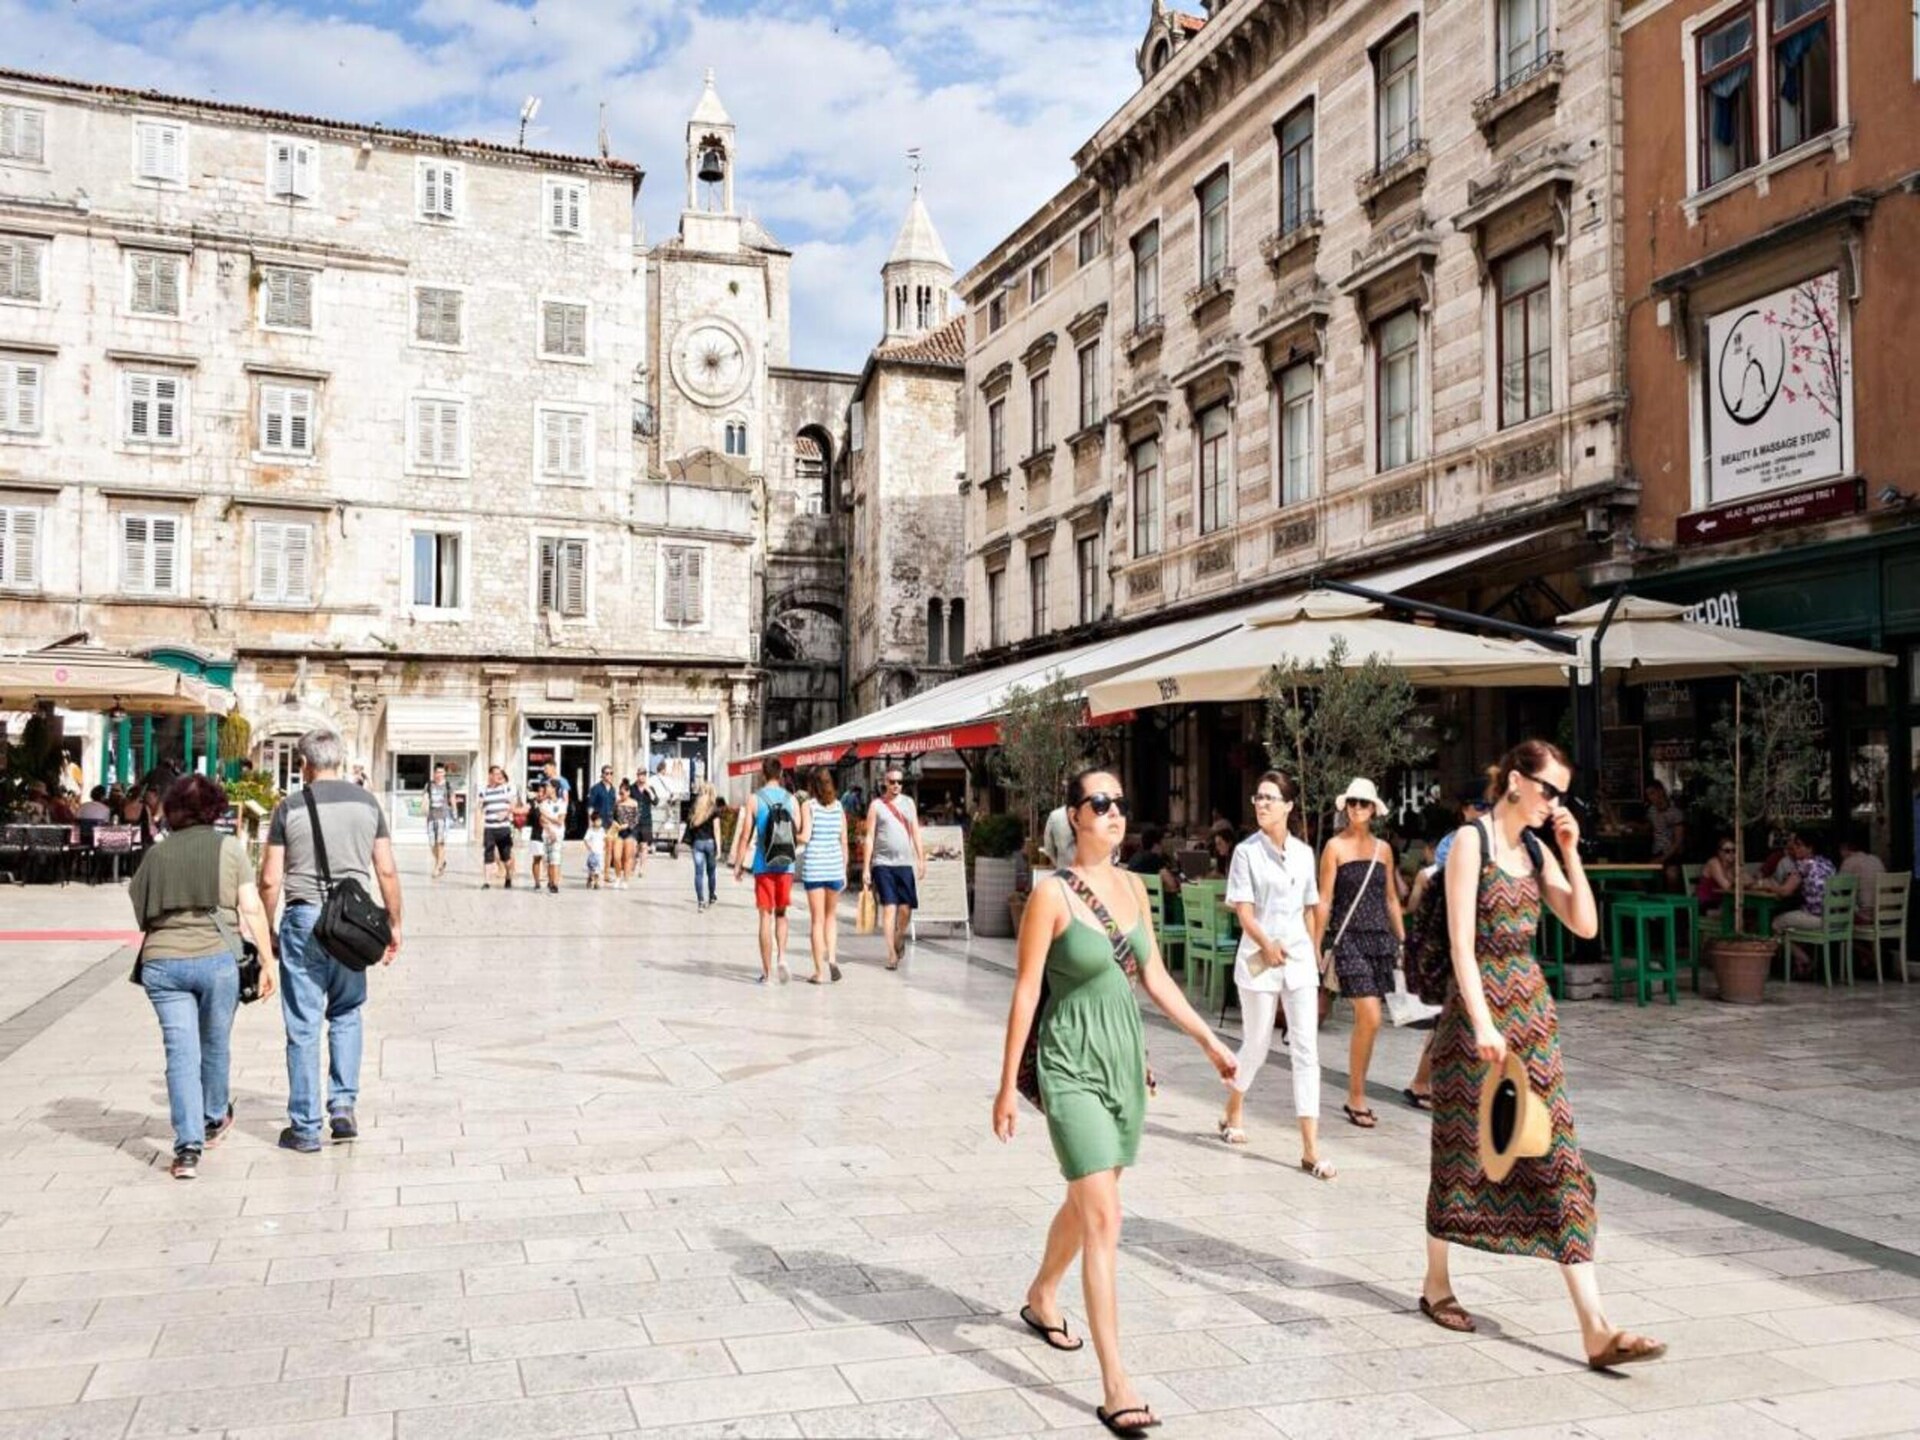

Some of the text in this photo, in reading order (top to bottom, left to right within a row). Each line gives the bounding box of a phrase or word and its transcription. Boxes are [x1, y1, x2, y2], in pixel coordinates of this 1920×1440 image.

[1721, 450, 1751, 466] BEAUTY
[1760, 436, 1798, 455] MASSAGE
[1800, 427, 1831, 446] STUDIO
